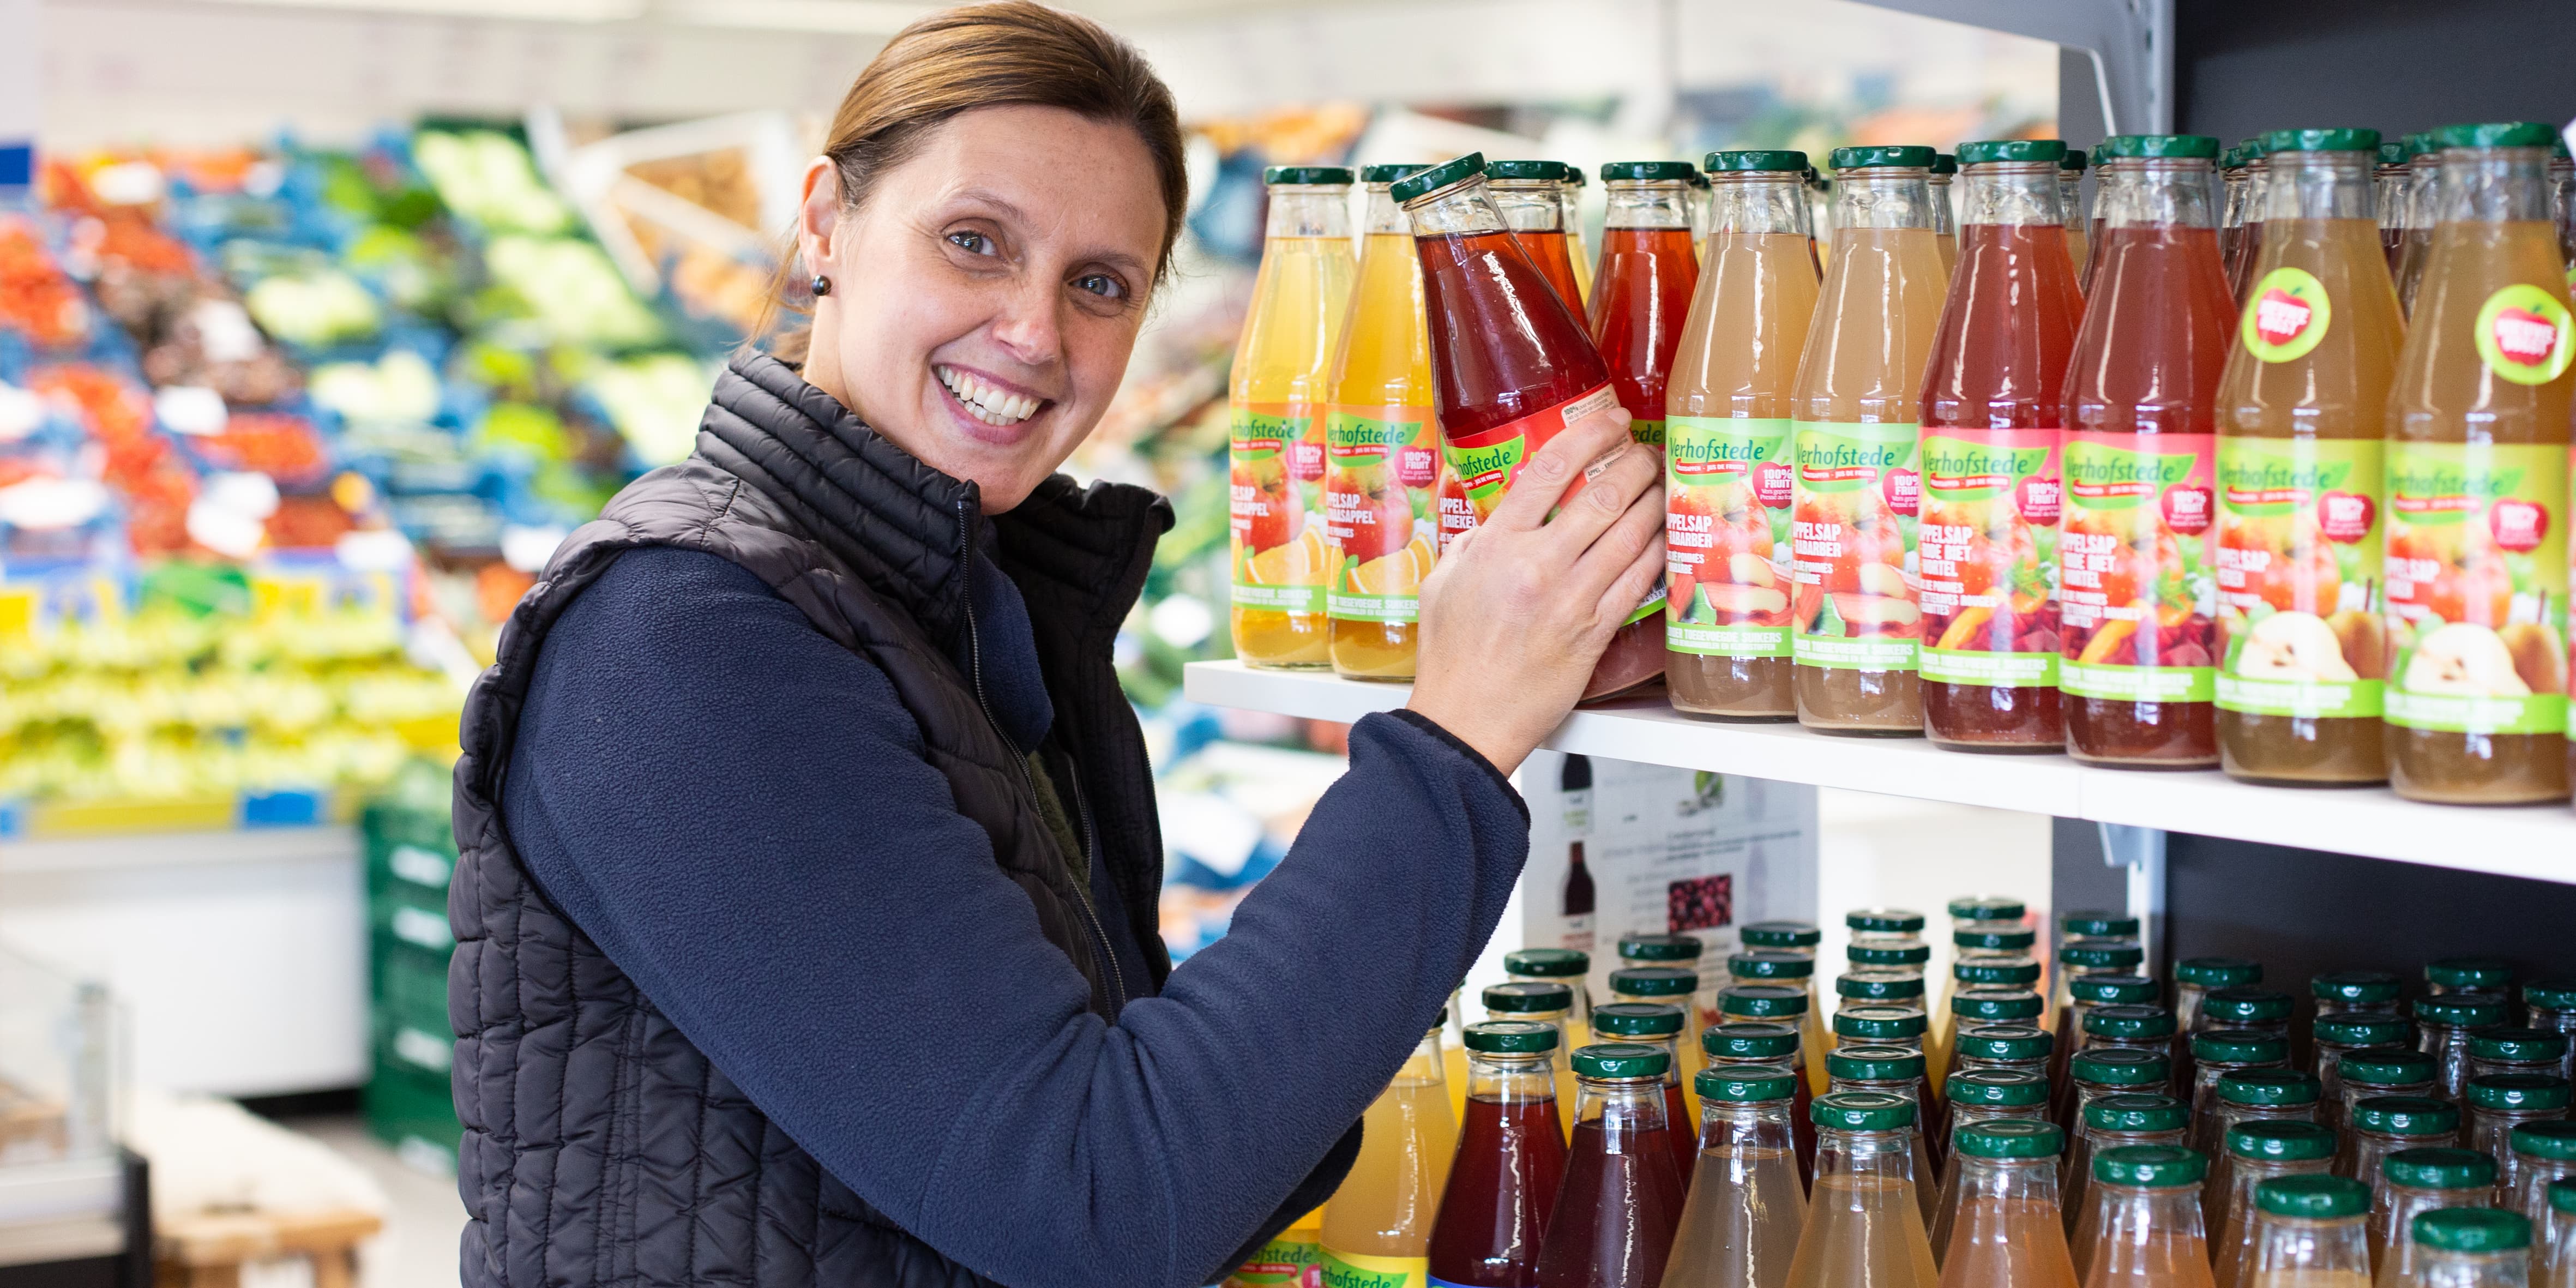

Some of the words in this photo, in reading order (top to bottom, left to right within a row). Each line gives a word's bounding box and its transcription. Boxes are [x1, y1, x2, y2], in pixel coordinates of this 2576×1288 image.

[1404, 452, 1431, 461] 100%
[1670, 437, 1765, 465] Verhofstede
[1796, 443, 1895, 471] Verhofstede
[1406, 461, 1430, 470] FRUIT
[1455, 448, 1512, 480] hofstede
[1923, 450, 2029, 480] Verhofstede
[1765, 479, 1791, 488] FRUIT
[1439, 497, 1473, 515] APPELS
